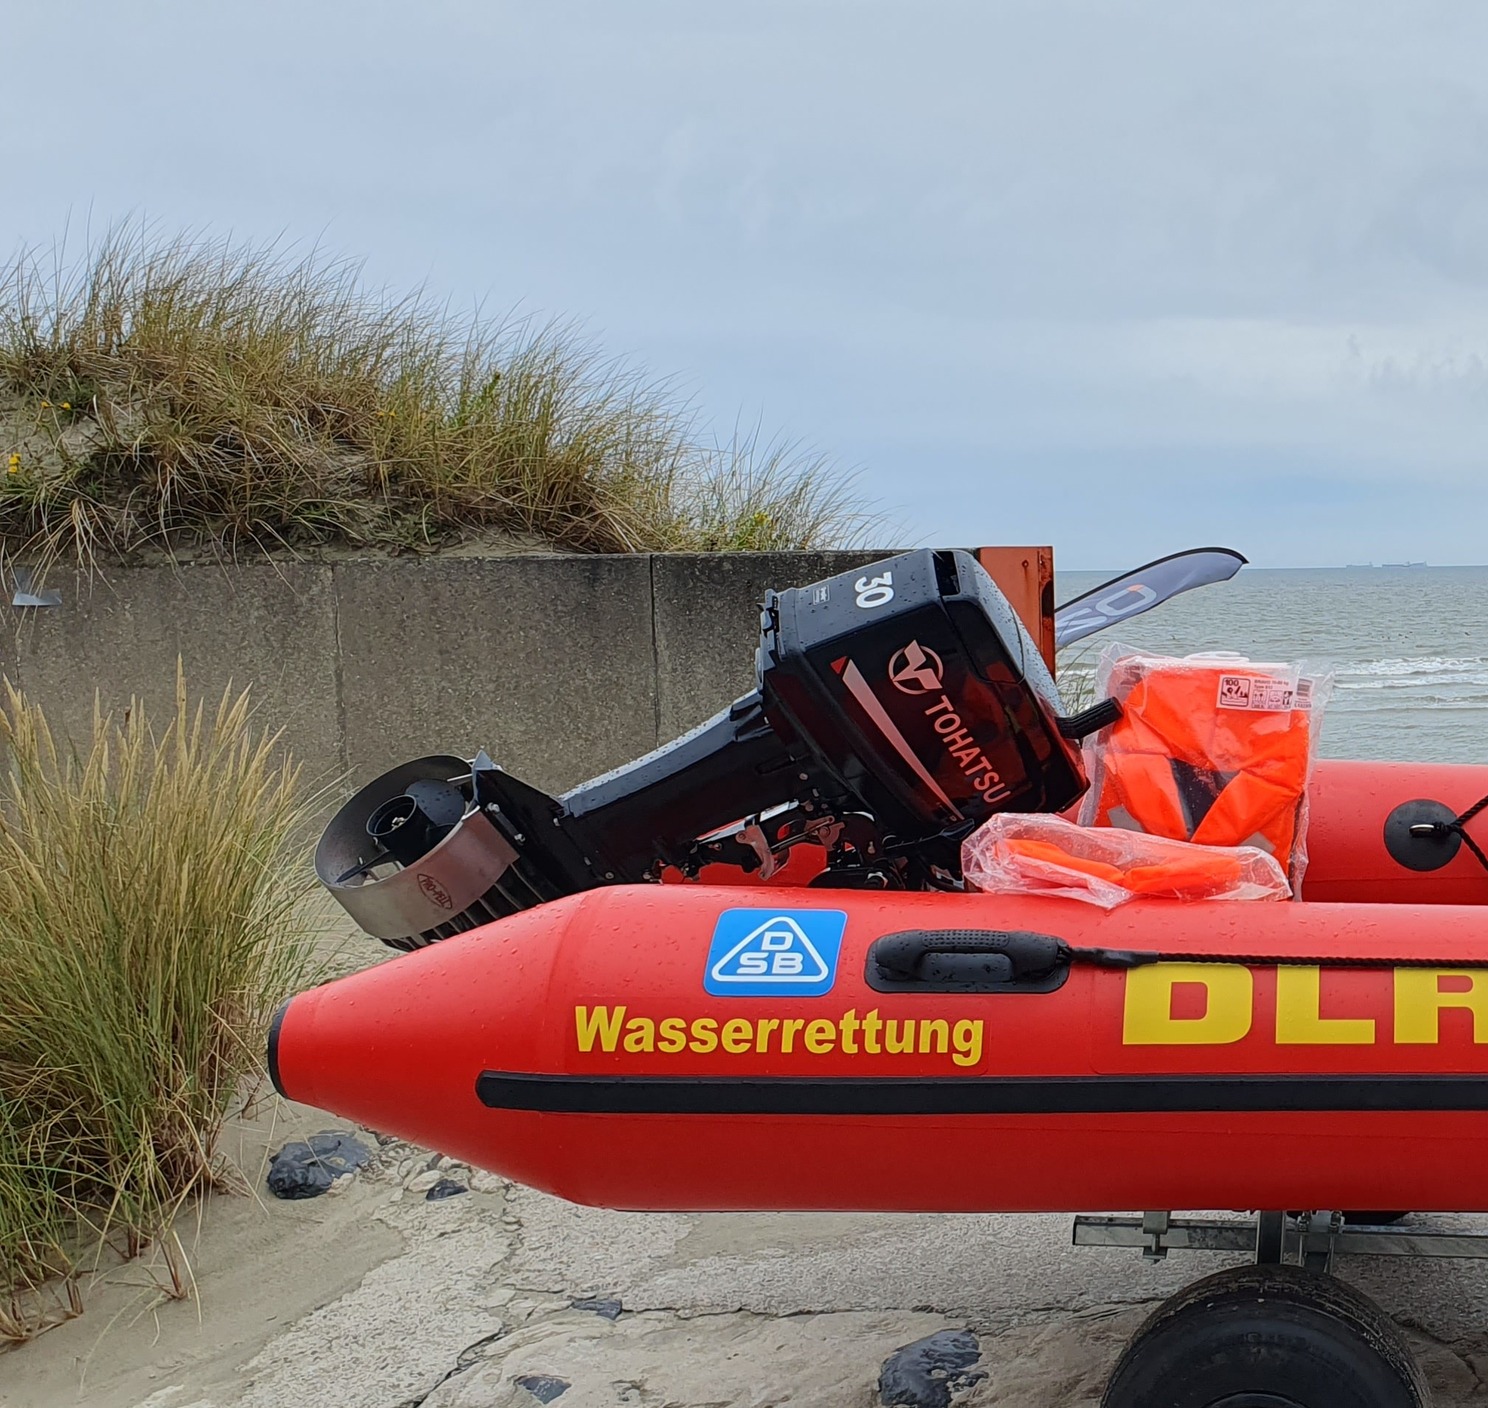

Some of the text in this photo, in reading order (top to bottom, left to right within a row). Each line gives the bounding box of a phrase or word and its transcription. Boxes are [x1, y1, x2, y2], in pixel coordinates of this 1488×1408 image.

[854, 571, 894, 609] 30
[1225, 679, 1239, 687] 100
[924, 694, 1011, 804] TOHATSU
[574, 1005, 985, 1066] Wasserrettung
